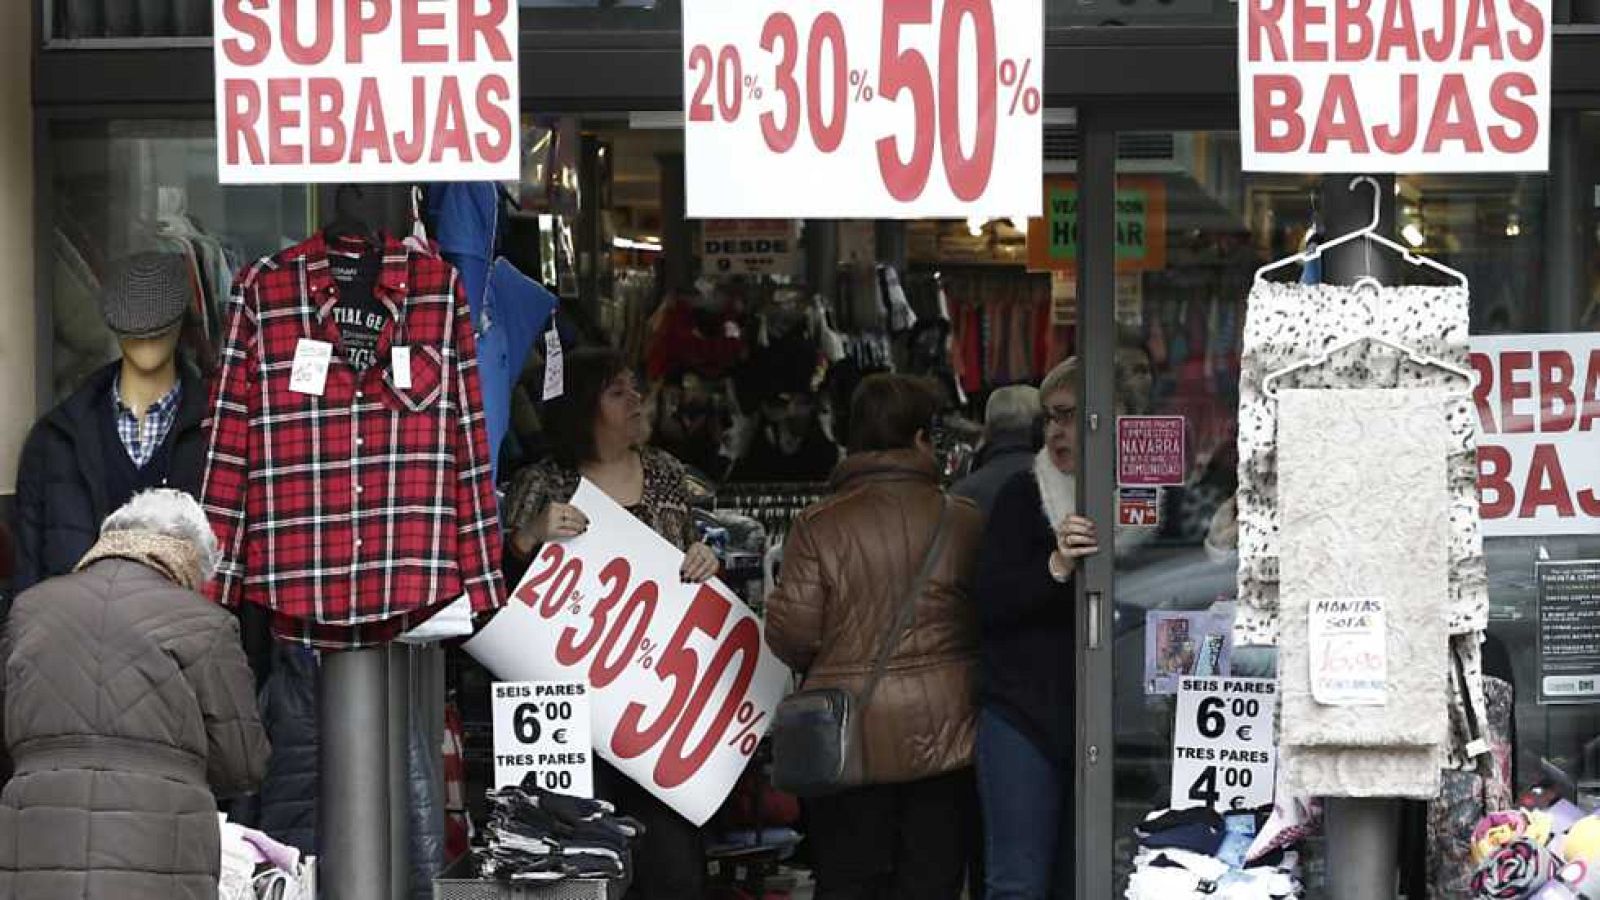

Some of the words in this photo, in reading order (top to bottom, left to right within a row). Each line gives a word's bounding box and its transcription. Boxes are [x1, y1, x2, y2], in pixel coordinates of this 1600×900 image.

[222, 0, 513, 65] SUPER
[1248, 0, 1544, 61] REBAJAS
[224, 74, 512, 165] REBAJAS
[1253, 72, 1540, 155] BAJAS
[704, 240, 785, 254] DESDE
[366, 312, 388, 332] GE
[1121, 440, 1180, 453] NAVARRA
[1316, 600, 1381, 613] MANTAS
[496, 686, 531, 698] SEIS
[535, 683, 586, 697] PARES
[1182, 679, 1219, 692] SEIS
[1223, 681, 1276, 694] PARES
[552, 727, 568, 744] €
[1236, 724, 1253, 741] €
[495, 755, 534, 766] TRES
[538, 752, 587, 765] PARES
[1176, 746, 1215, 760] TRES
[1219, 749, 1269, 764] PARES
